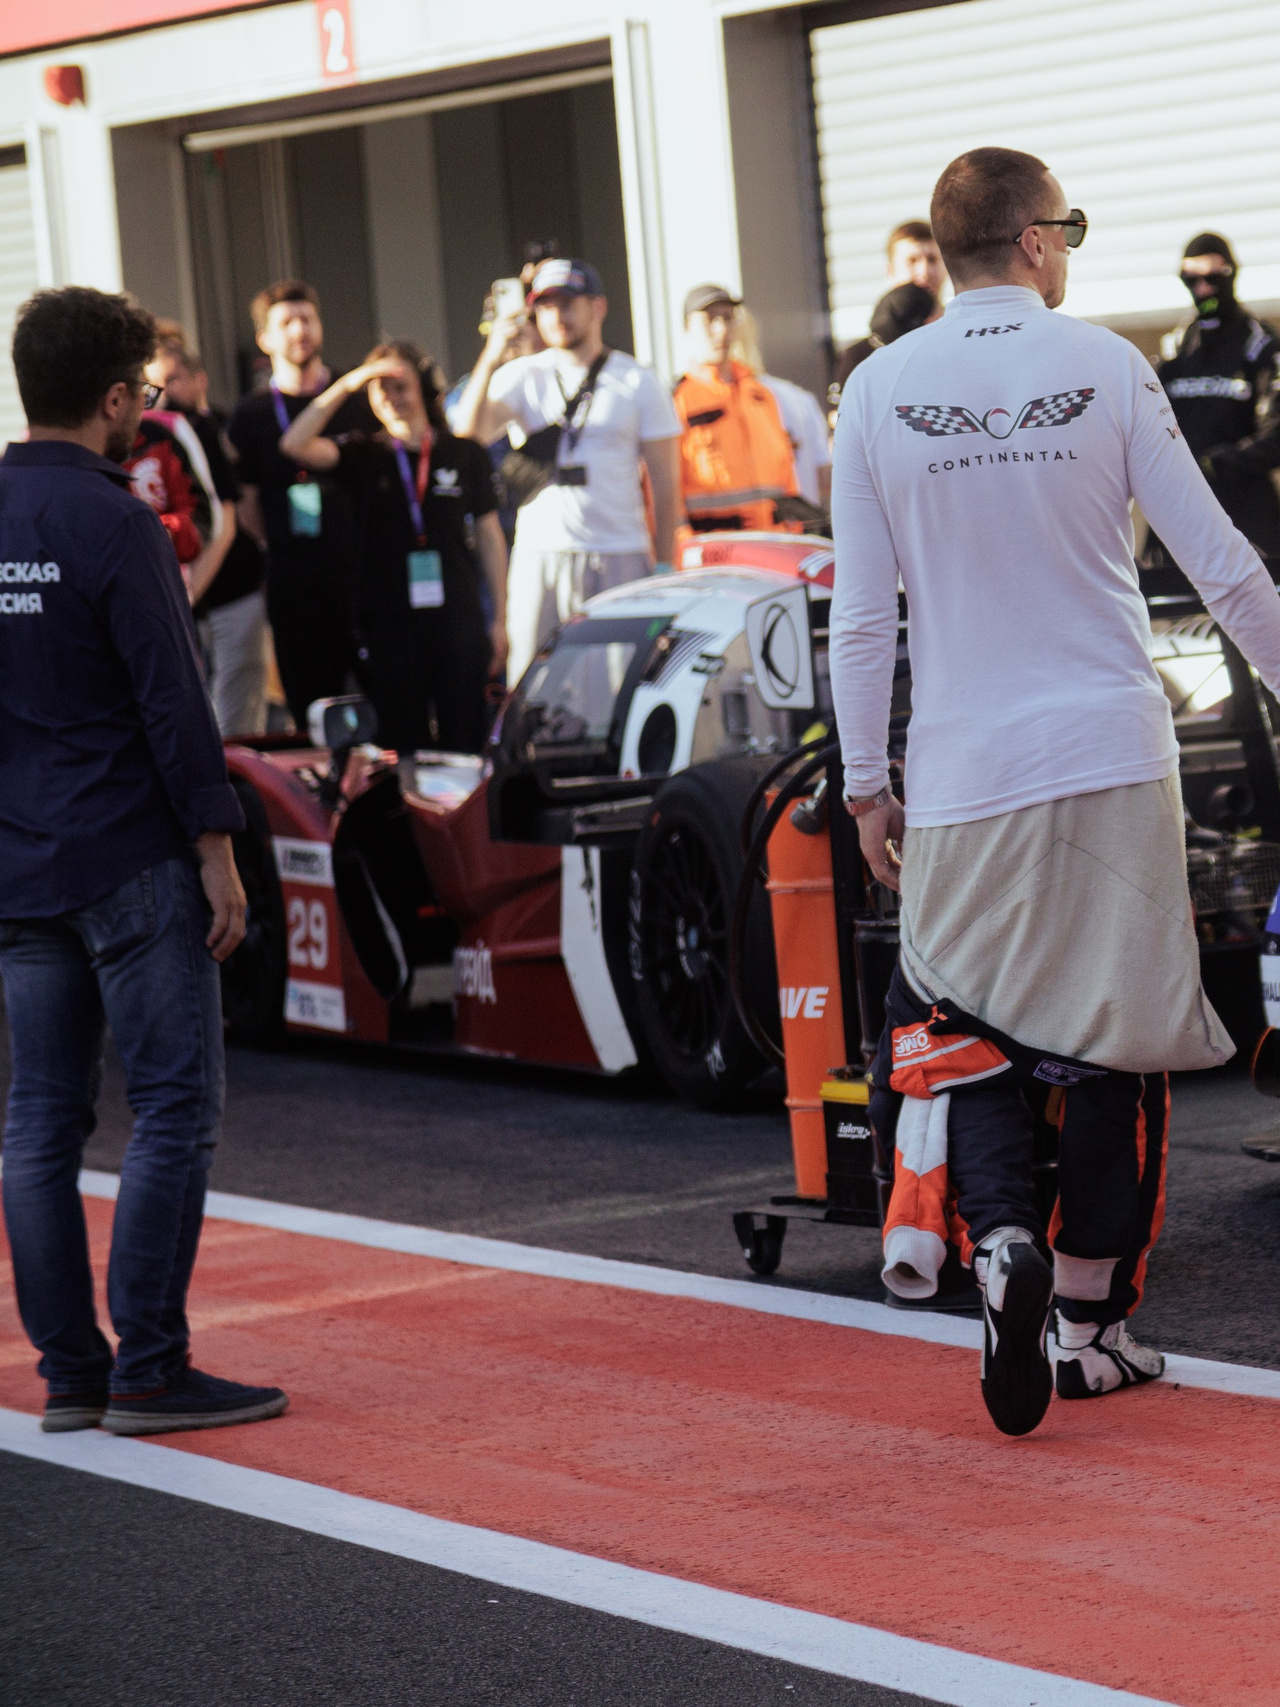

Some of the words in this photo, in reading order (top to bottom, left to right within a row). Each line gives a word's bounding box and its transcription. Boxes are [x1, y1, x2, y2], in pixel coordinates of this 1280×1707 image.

[323, 8, 348, 73] 2
[965, 322, 1025, 338] HRX
[928, 449, 1079, 474] CONTINENTAL
[0, 561, 61, 583] СКАЯ
[0, 592, 43, 614] СИЯ
[288, 897, 328, 970] 29
